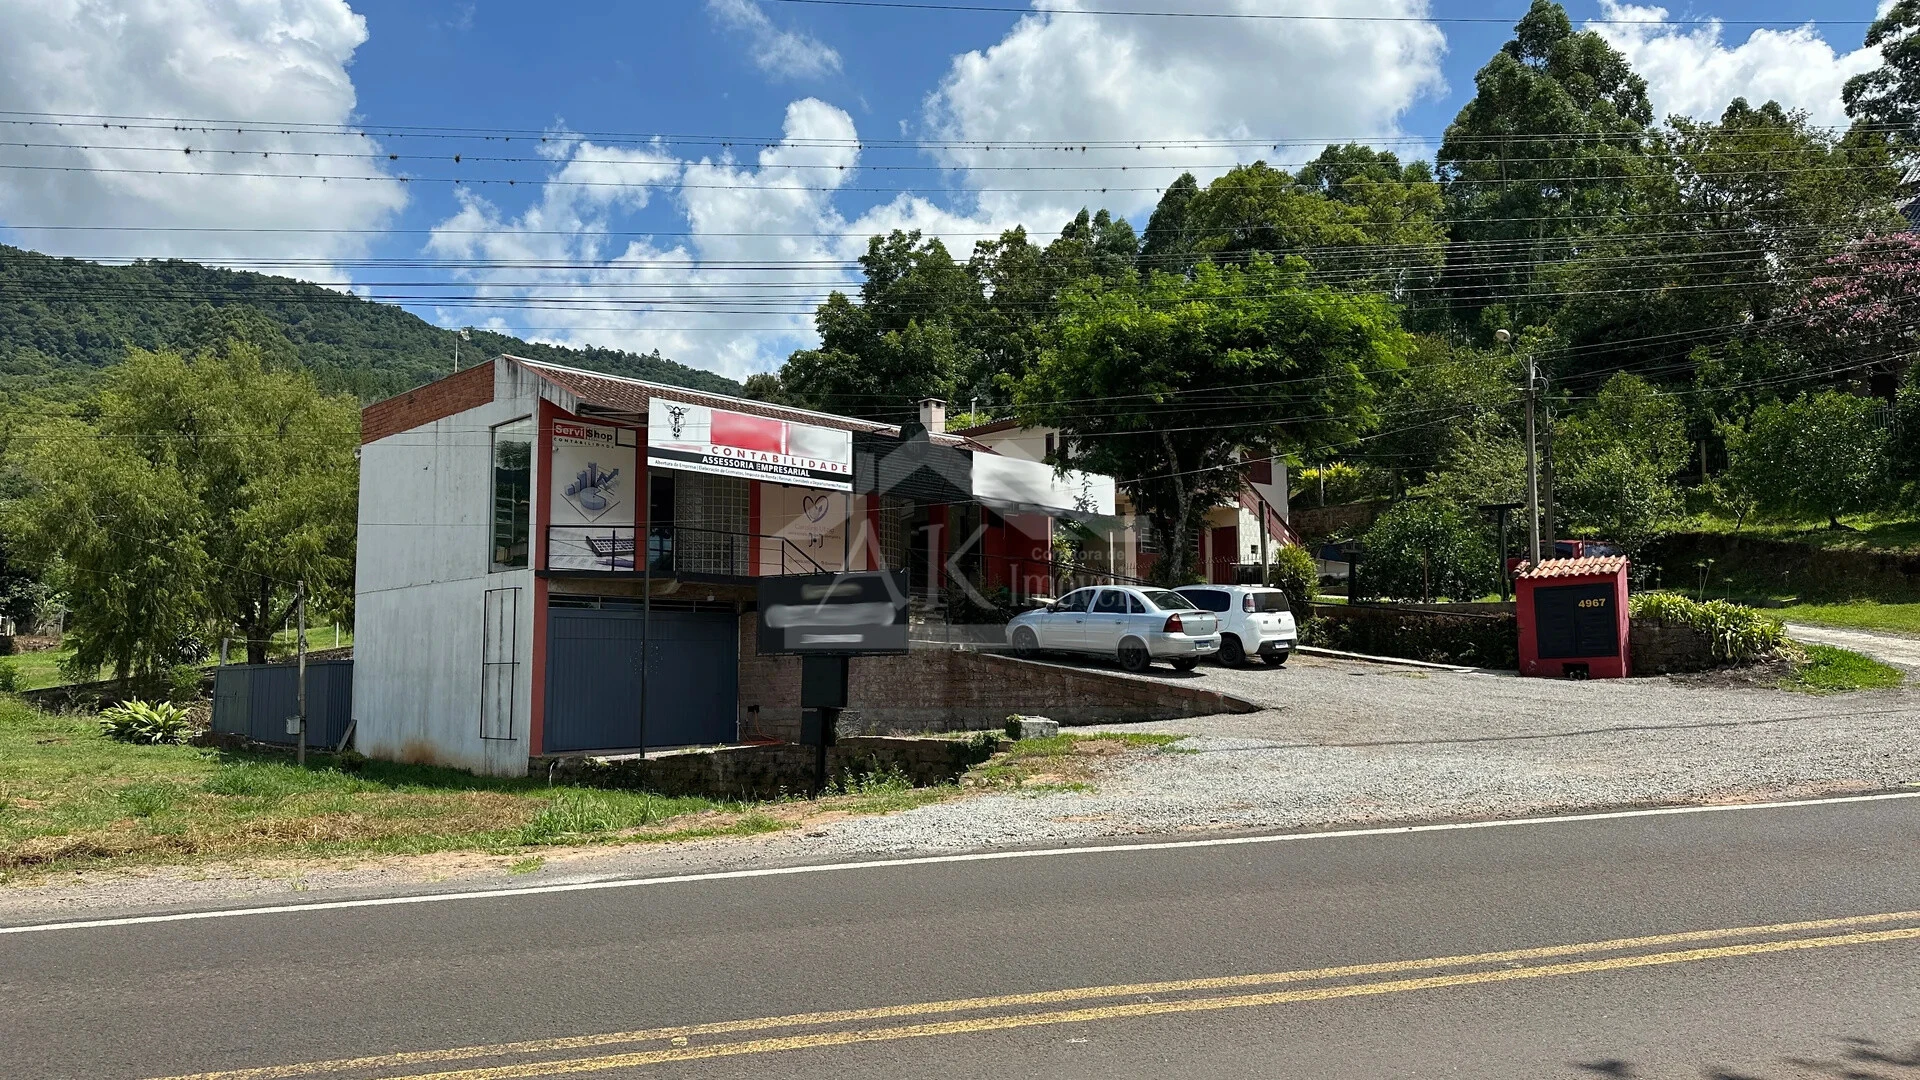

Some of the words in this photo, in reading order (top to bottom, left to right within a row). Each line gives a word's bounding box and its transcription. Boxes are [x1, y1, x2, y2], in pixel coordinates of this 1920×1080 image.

[555, 424, 584, 437] Servi
[586, 427, 613, 442] Shop
[553, 437, 615, 449] CONTABILIDADE
[701, 455, 754, 470] ASSESSORIA
[756, 463, 811, 478] EMPRESARIAL
[711, 446, 848, 473] CONTABILIDADE
[1578, 598, 1606, 608] 4967
